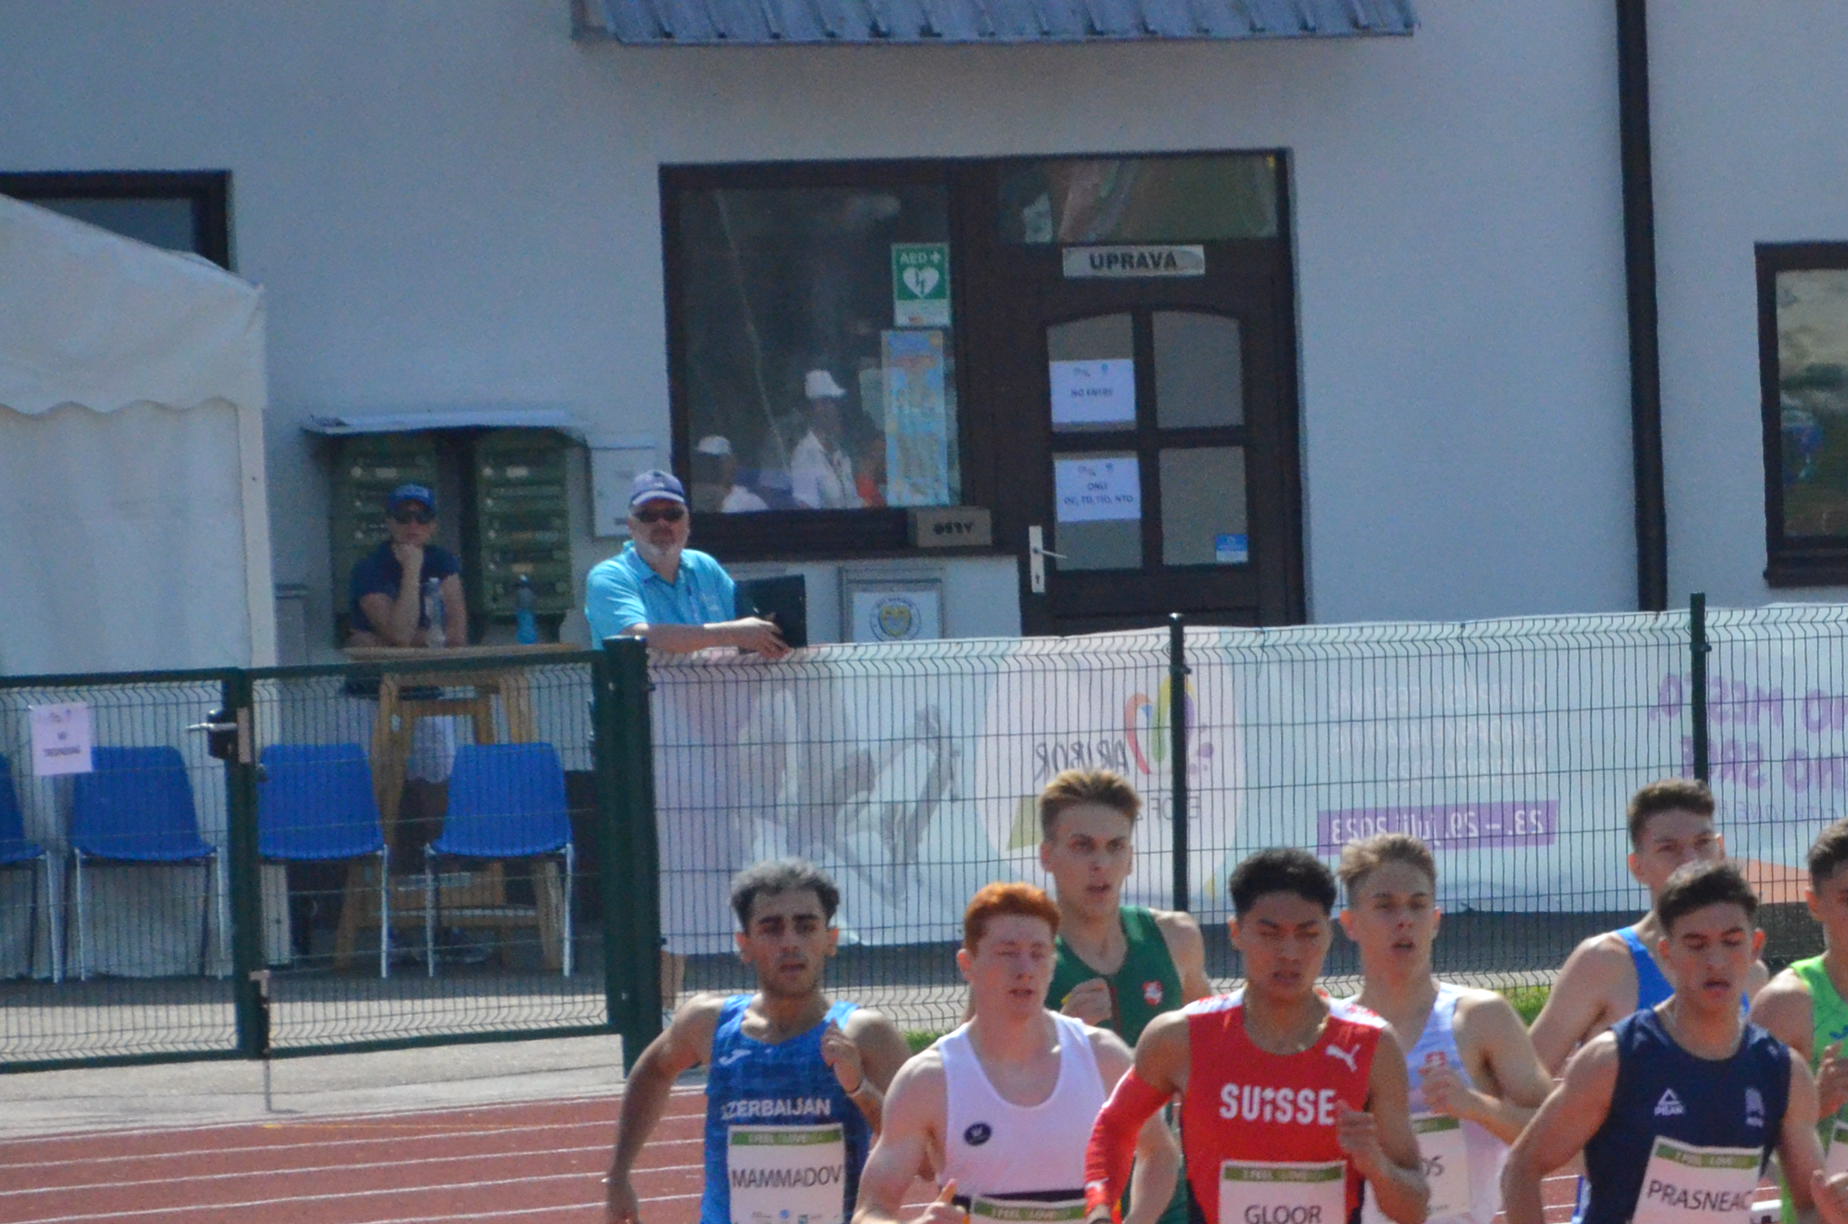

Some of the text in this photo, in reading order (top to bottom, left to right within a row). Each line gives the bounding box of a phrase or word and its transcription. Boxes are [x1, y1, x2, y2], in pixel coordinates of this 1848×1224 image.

[900, 252, 928, 265] AED
[1089, 251, 1177, 270] UPRAVA
[731, 1164, 842, 1188] MAMMADOV
